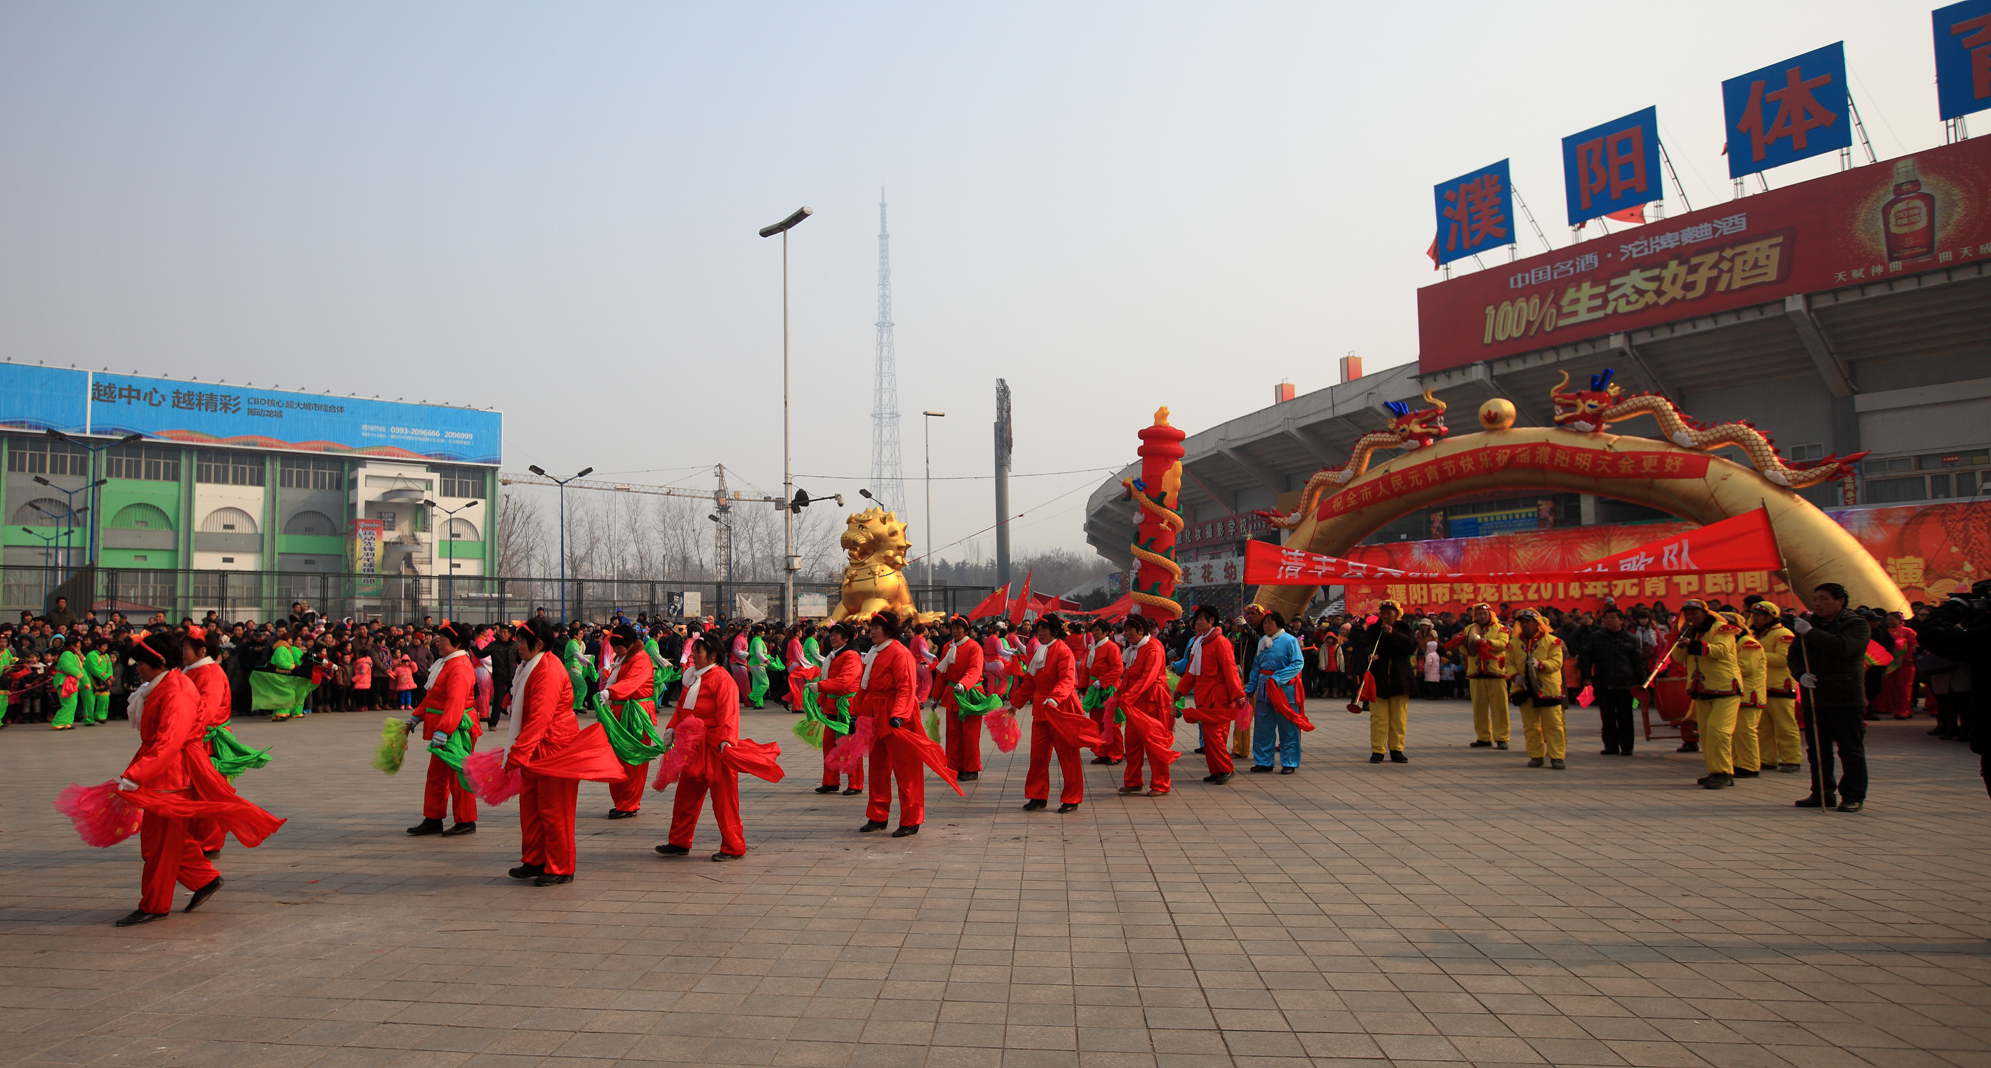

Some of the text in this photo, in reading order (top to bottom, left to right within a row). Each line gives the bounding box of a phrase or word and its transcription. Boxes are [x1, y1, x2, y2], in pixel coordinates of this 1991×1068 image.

[92, 381, 241, 414] 越中心 越精彩
